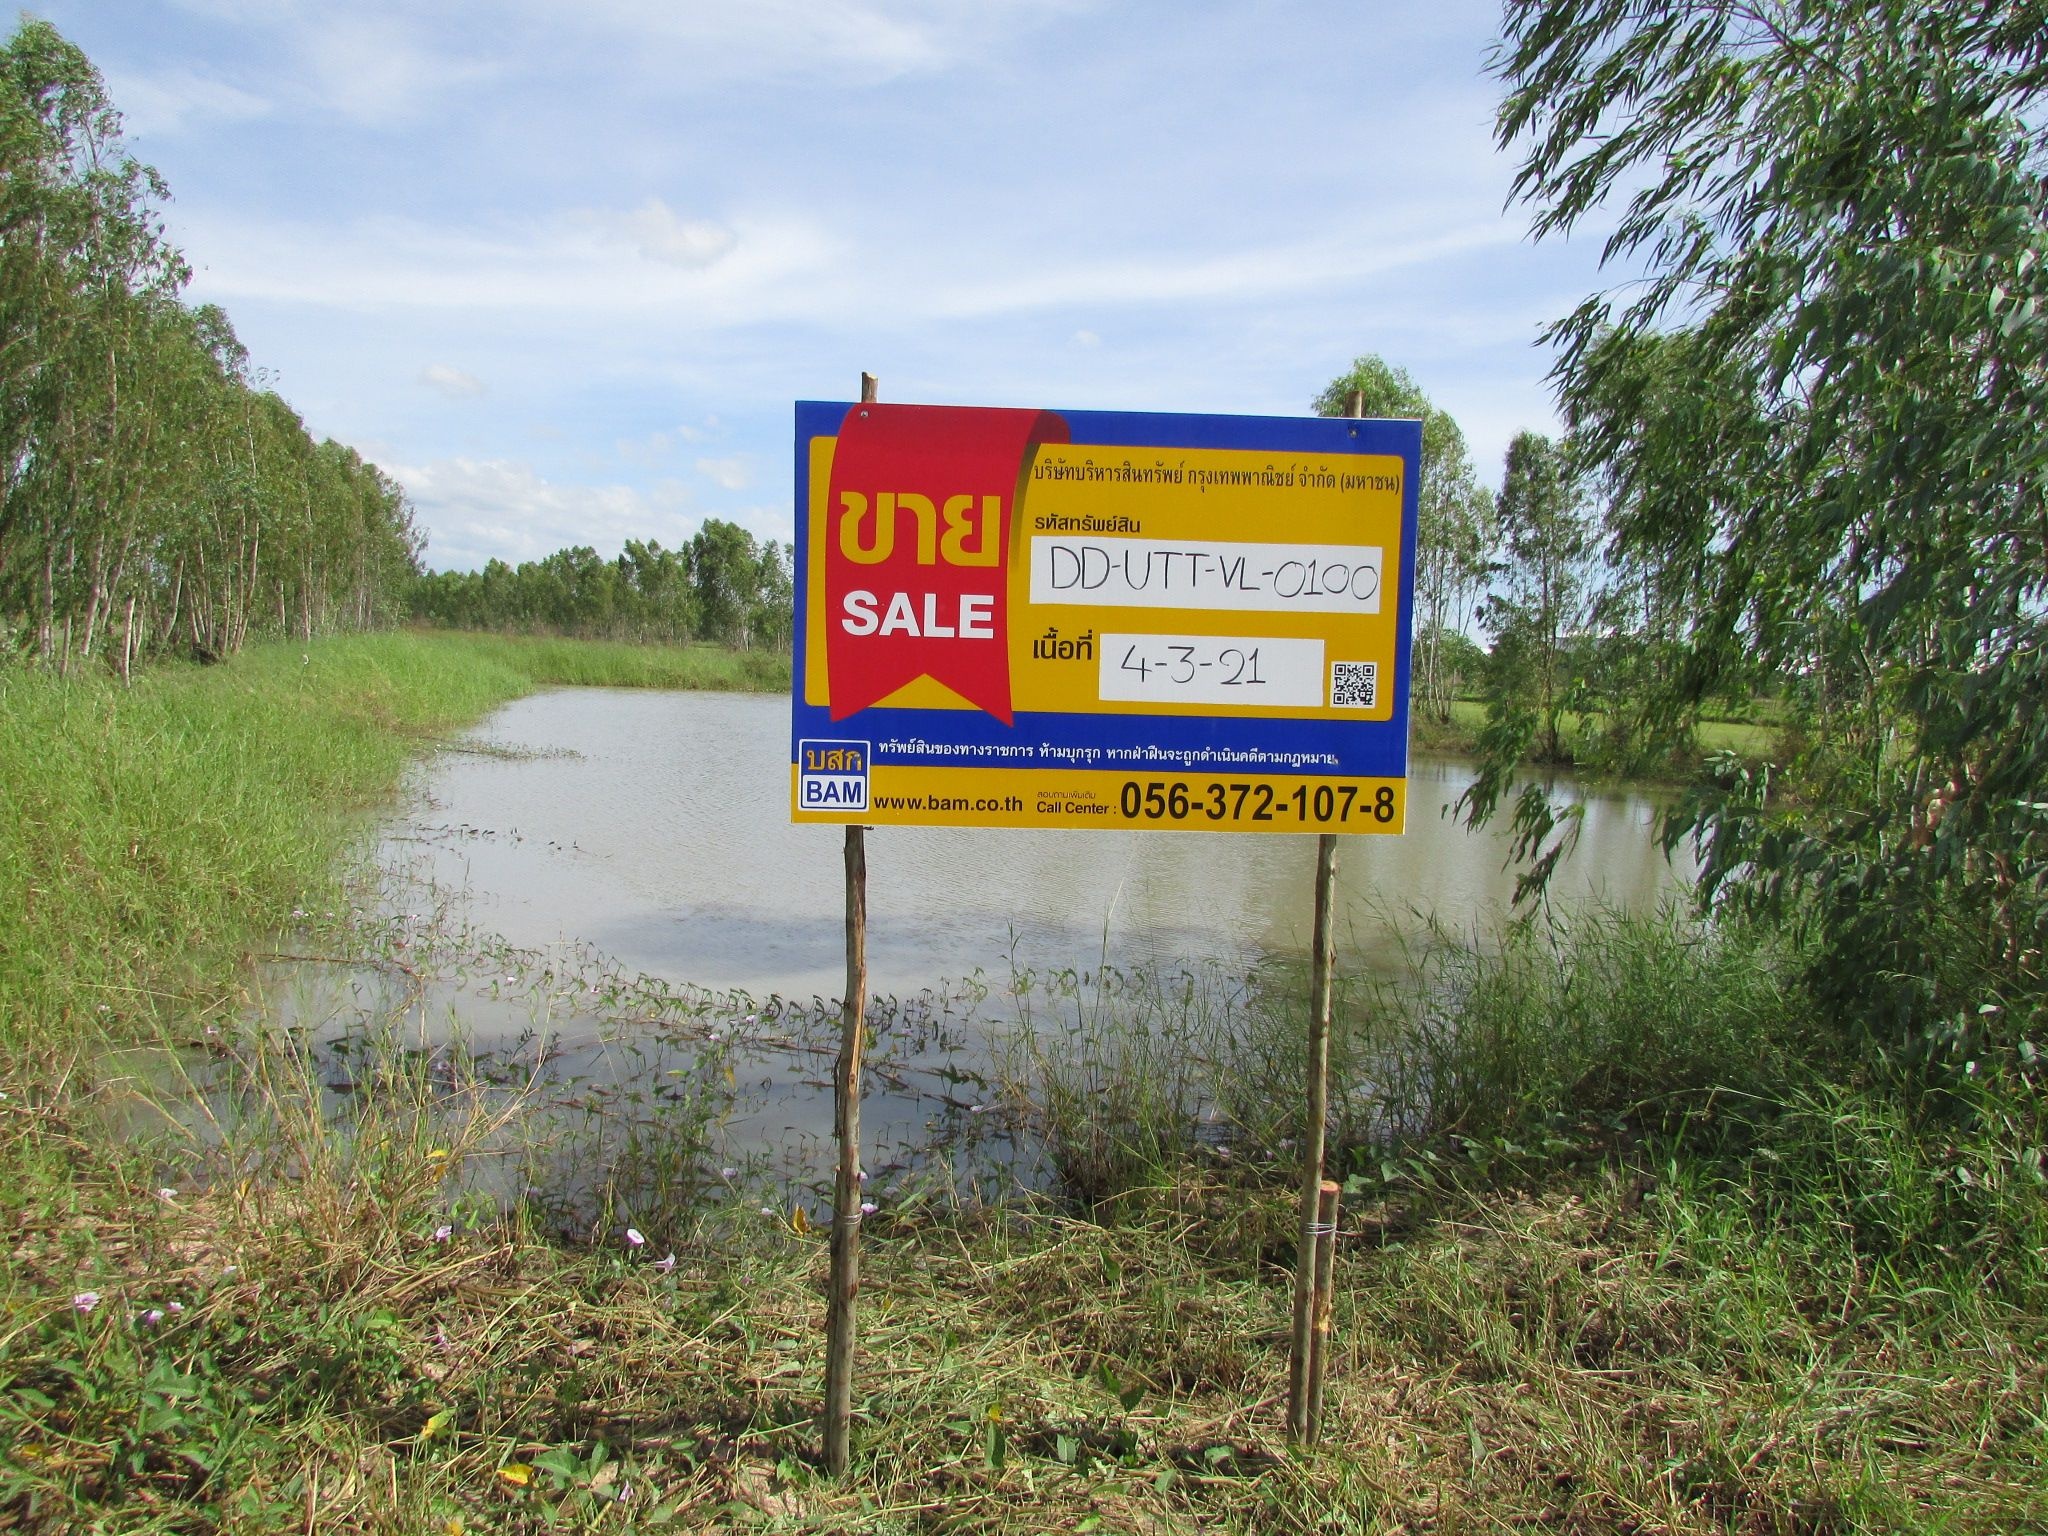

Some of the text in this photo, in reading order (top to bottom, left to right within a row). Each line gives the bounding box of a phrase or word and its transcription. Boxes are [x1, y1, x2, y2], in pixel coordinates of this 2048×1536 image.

[1034, 457, 1400, 495] บริษัทบริหารสินทรัพย์ กรุงเทพพาณิชย์ จำกัด (มหาชน)
[840, 491, 1001, 567] ขาย
[1035, 513, 1141, 533] รหัสทรัพย์สิน
[1050, 546, 1378, 600] DD-UTT-VL-0100
[841, 590, 994, 639] SALE
[1033, 627, 1093, 660] เนื้อที่
[1121, 645, 1266, 685] 4-3-21
[806, 748, 862, 772] บสก
[879, 738, 1034, 757] ทรัพย์สินของทางราชการ
[1039, 743, 1101, 764] ห้ามบุกรุก
[806, 780, 862, 803] BAM
[874, 795, 1023, 812] www.bam.co.th
[1036, 801, 1061, 813] Call
[1065, 802, 1109, 814] Center
[1120, 781, 1395, 823] 056-372-107-8
